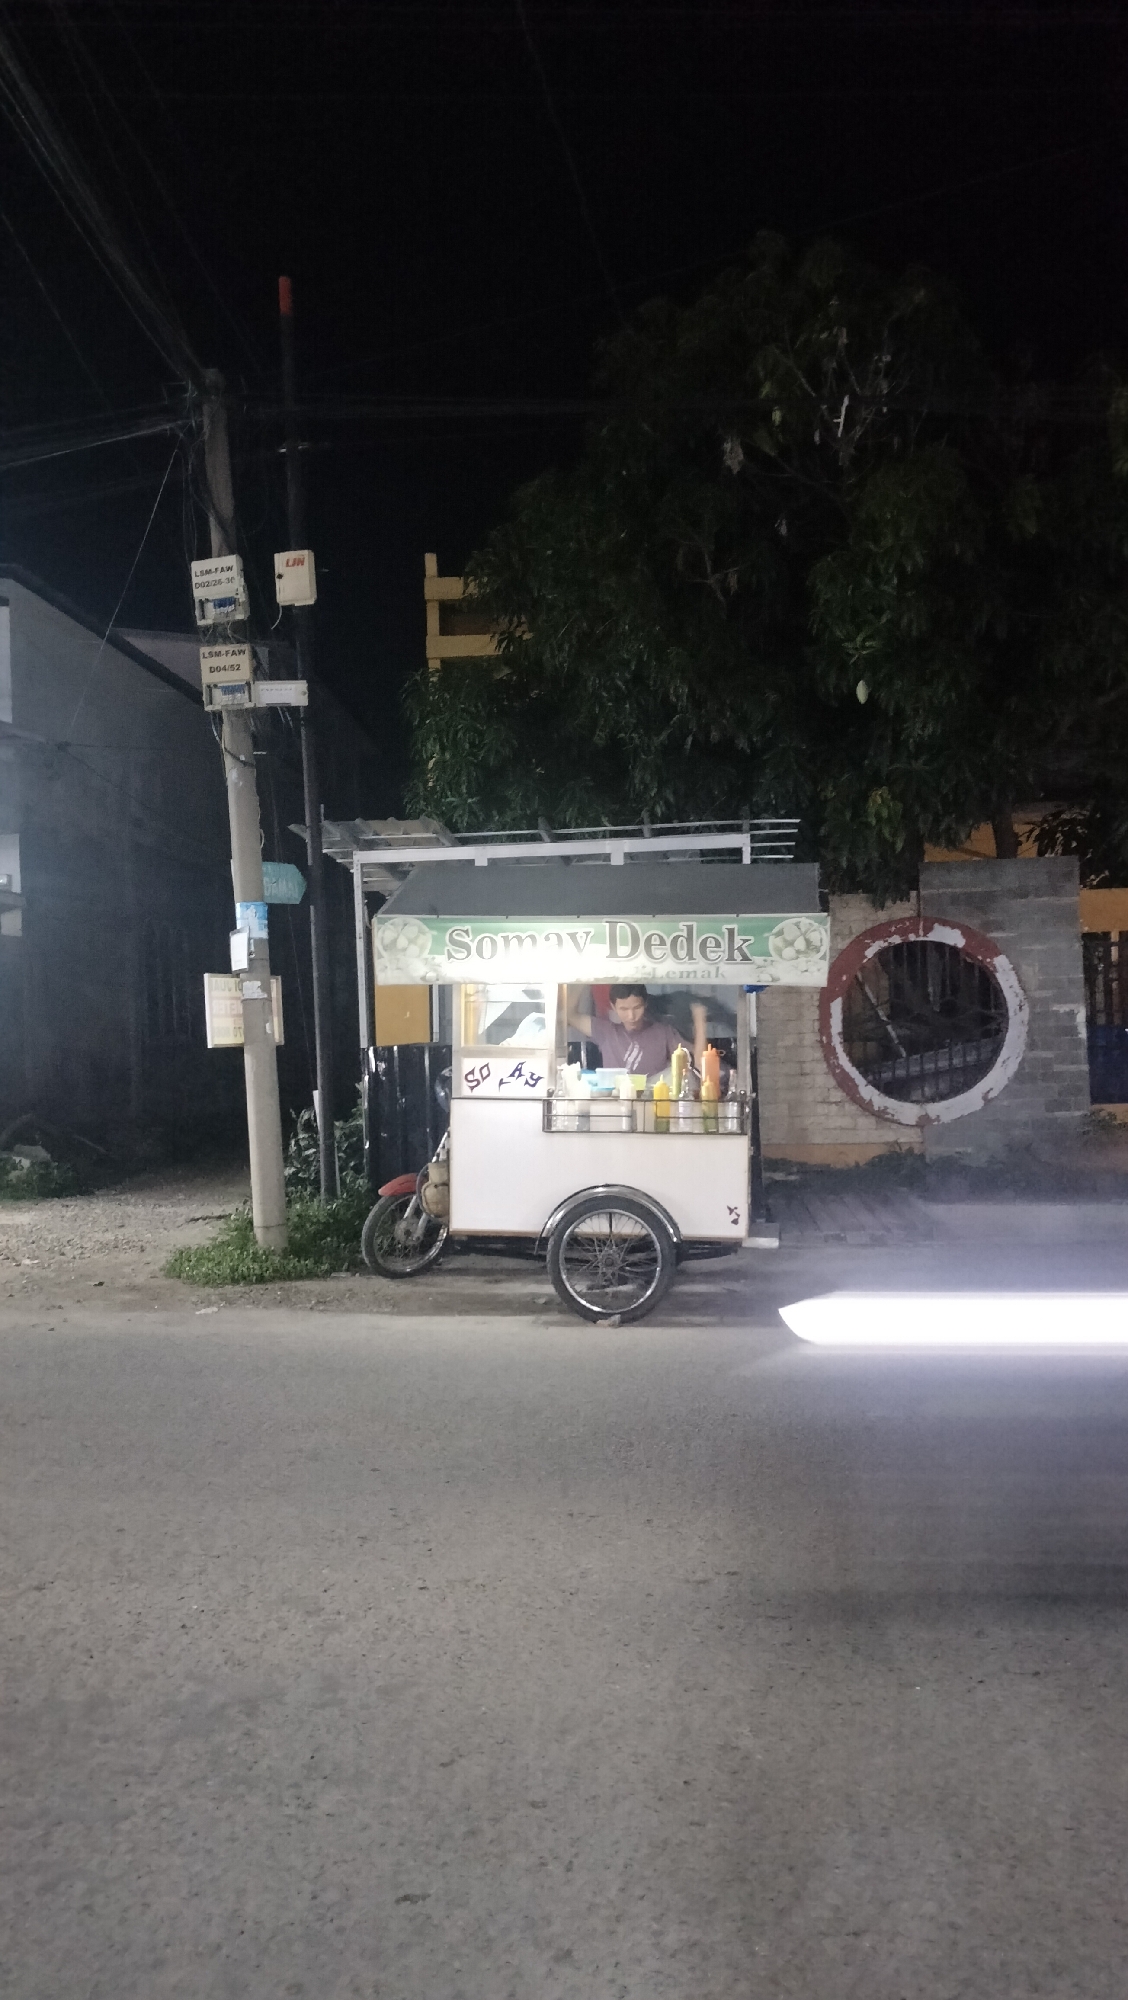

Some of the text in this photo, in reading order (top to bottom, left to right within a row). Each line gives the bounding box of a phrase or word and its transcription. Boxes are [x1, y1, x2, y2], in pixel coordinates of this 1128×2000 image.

[194, 565, 234, 578] LSM-FAW
[202, 648, 247, 660] LSM-FAW
[209, 663, 242, 674] D04/52
[604, 920, 753, 963] Dedek
